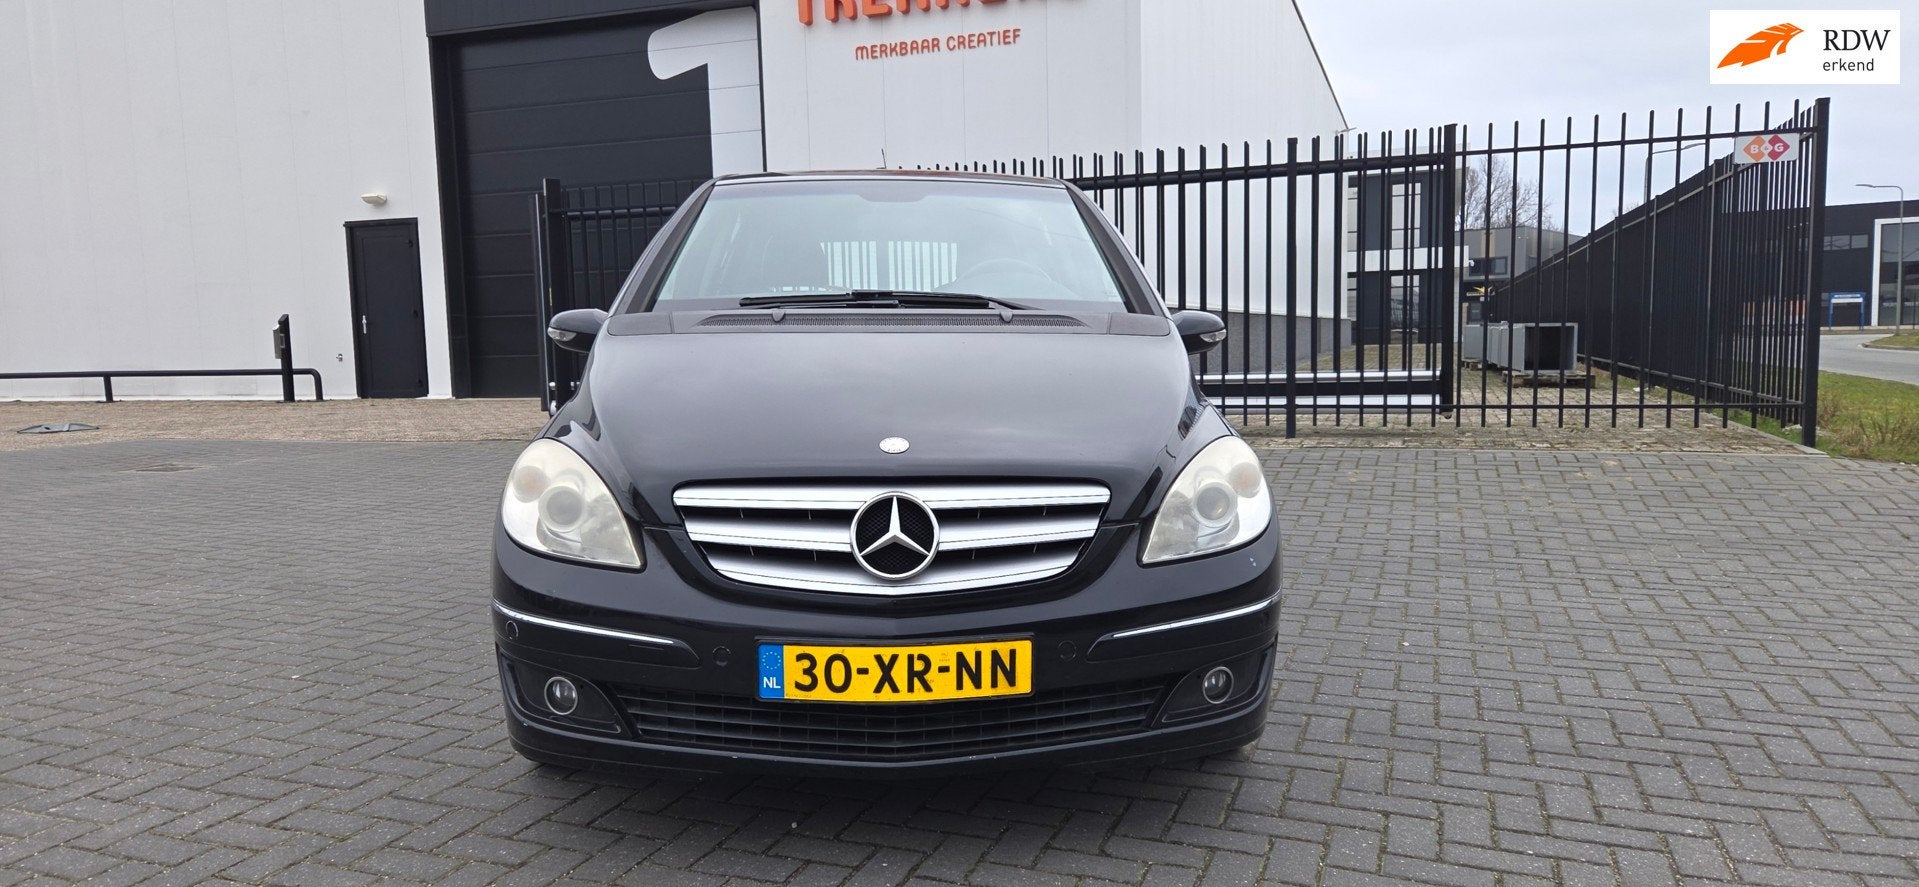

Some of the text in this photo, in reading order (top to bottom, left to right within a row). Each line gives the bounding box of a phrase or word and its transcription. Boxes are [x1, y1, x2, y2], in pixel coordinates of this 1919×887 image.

[855, 28, 1021, 61] MERKBAAR CREATIEF
[763, 676, 781, 689] NL
[794, 648, 1017, 694] 30-XR-NN
